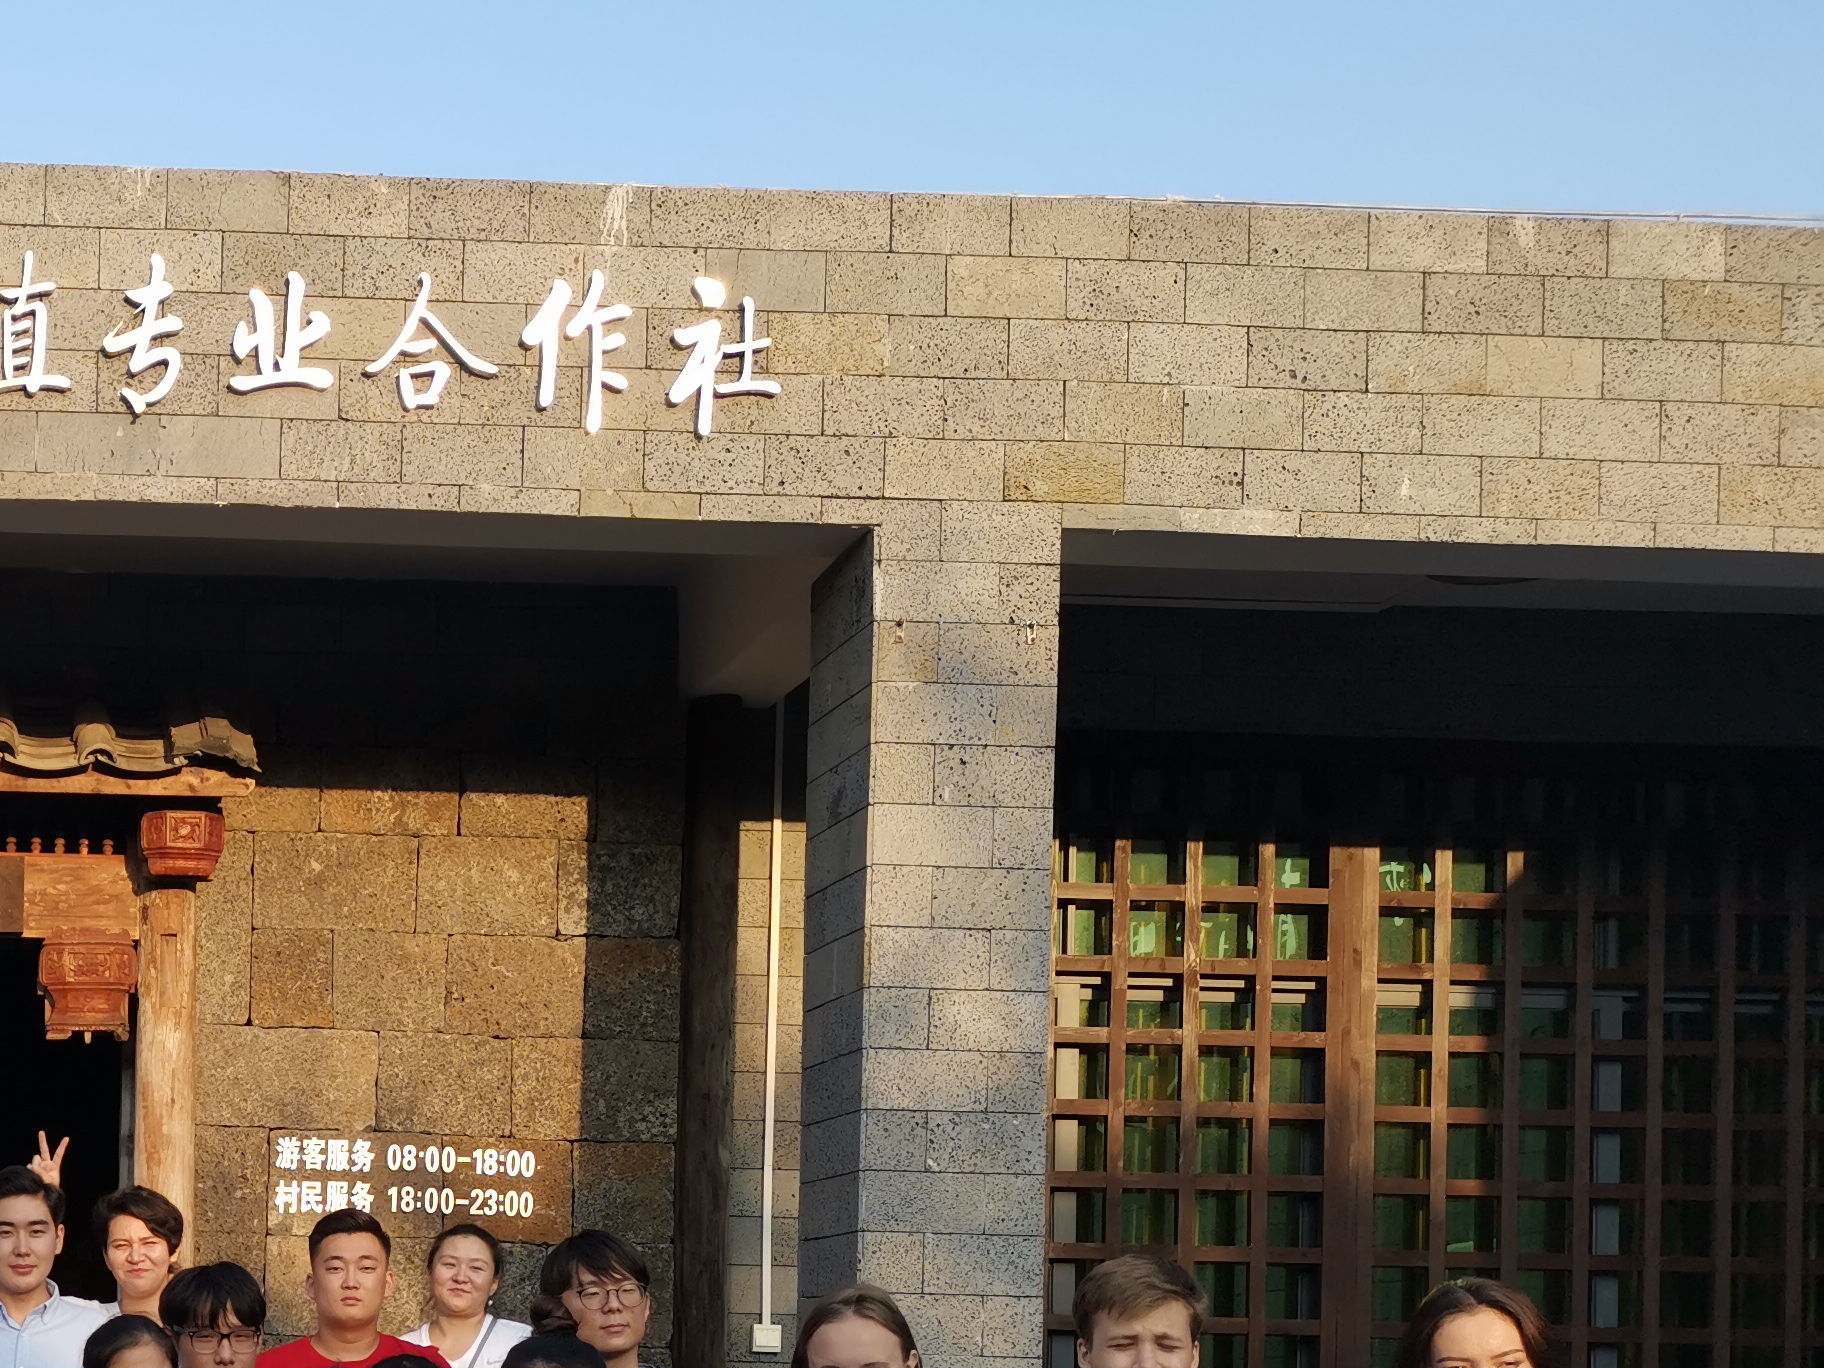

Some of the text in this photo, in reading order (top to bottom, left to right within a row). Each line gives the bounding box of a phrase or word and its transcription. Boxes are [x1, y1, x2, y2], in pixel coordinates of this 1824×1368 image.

[275, 1136, 376, 1172] 游客服务
[274, 1179, 534, 1218] 村民服务 18:00-23:00
